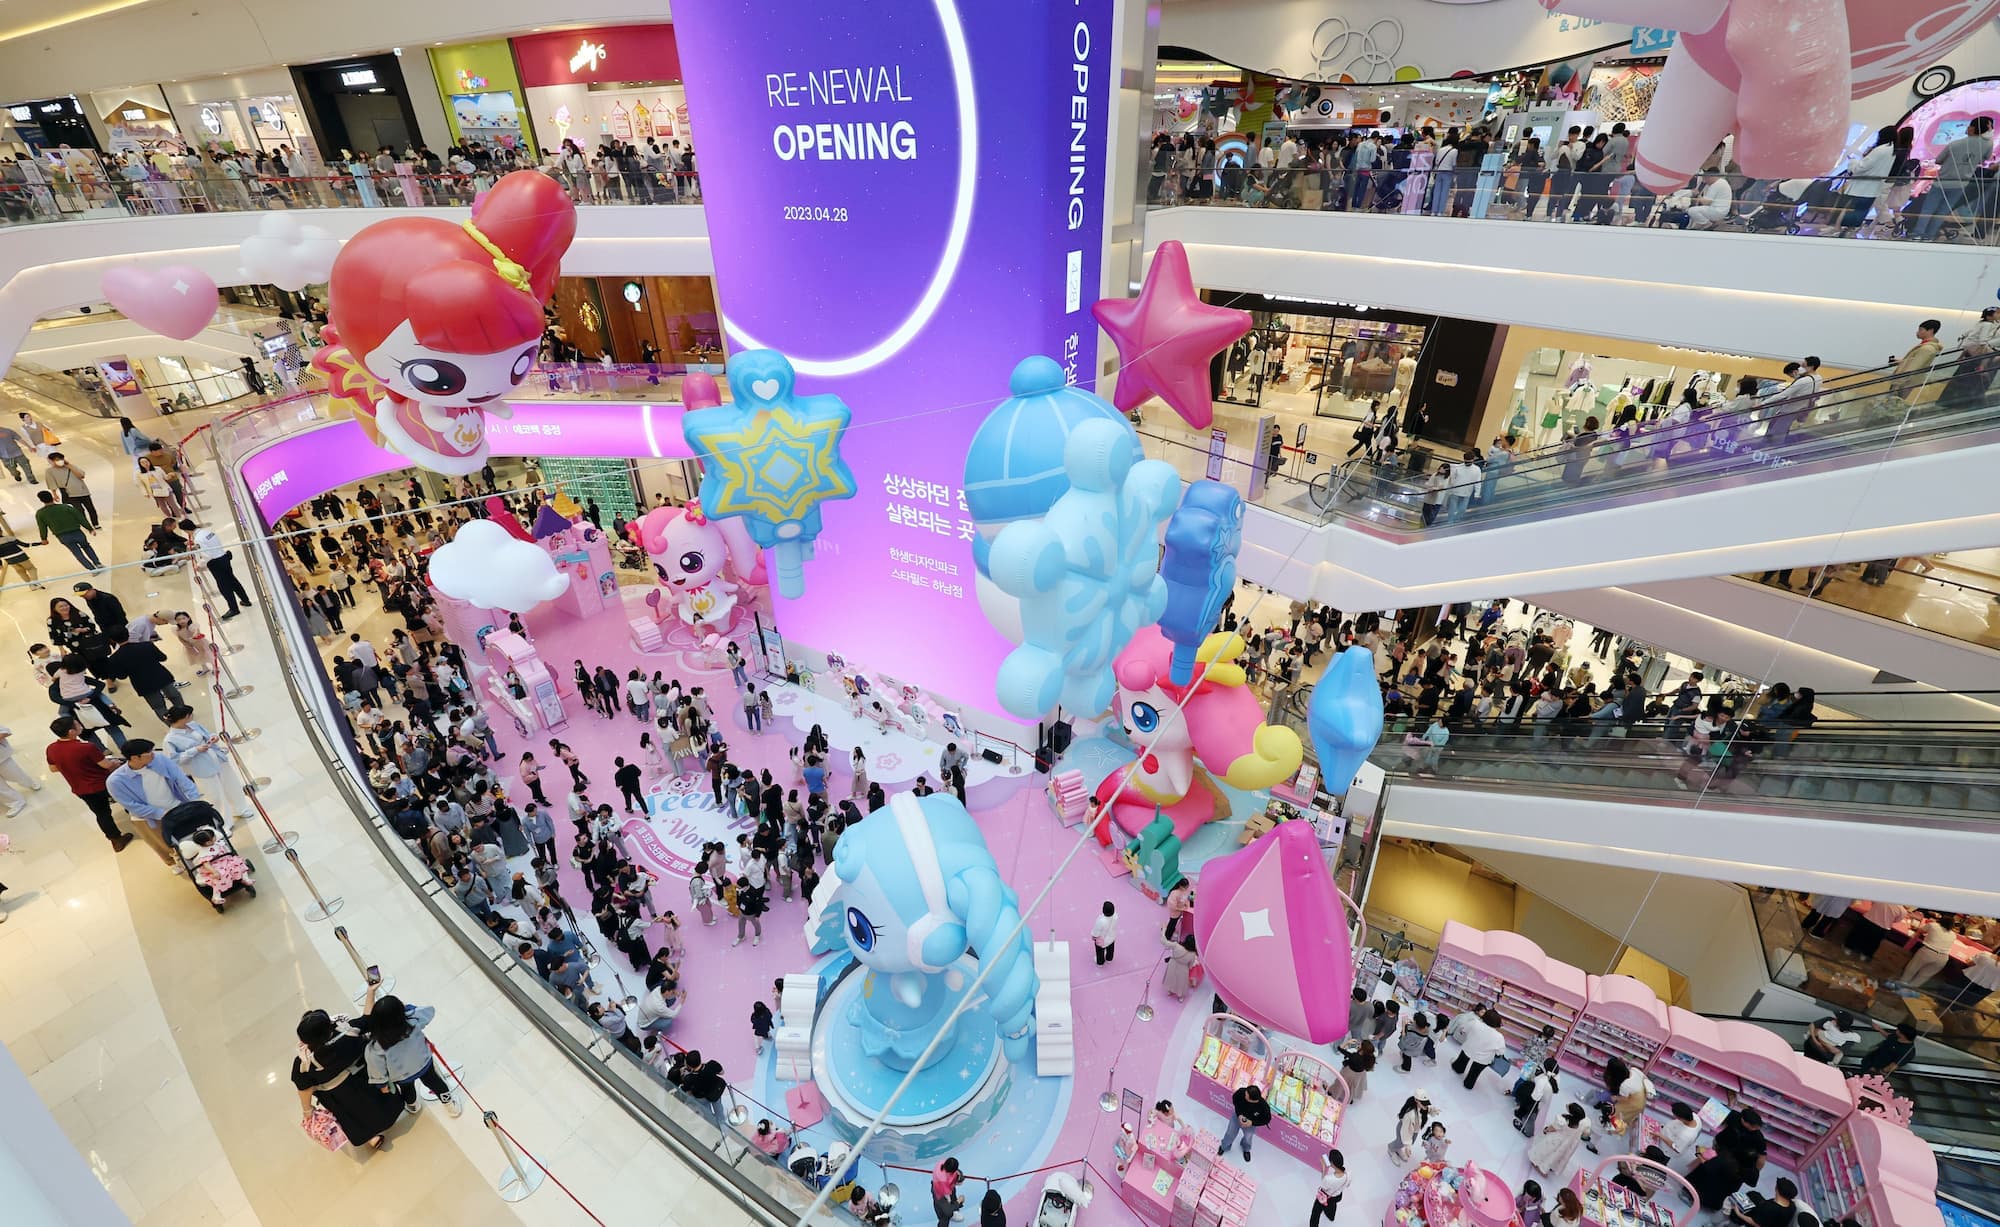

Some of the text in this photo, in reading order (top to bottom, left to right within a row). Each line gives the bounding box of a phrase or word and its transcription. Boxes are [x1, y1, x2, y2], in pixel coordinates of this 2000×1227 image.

[766, 65, 912, 107] RE-NEWAL
[773, 121, 917, 160] OPENING
[1068, 21, 1090, 230] OPENING
[783, 206, 848, 222] 2023.04.28
[883, 473, 950, 507] 상상하던
[886, 502, 975, 541] 실현되는 곳
[888, 547, 959, 576] 한샘디자인파크
[891, 569, 963, 599] 스타필드 하남점
